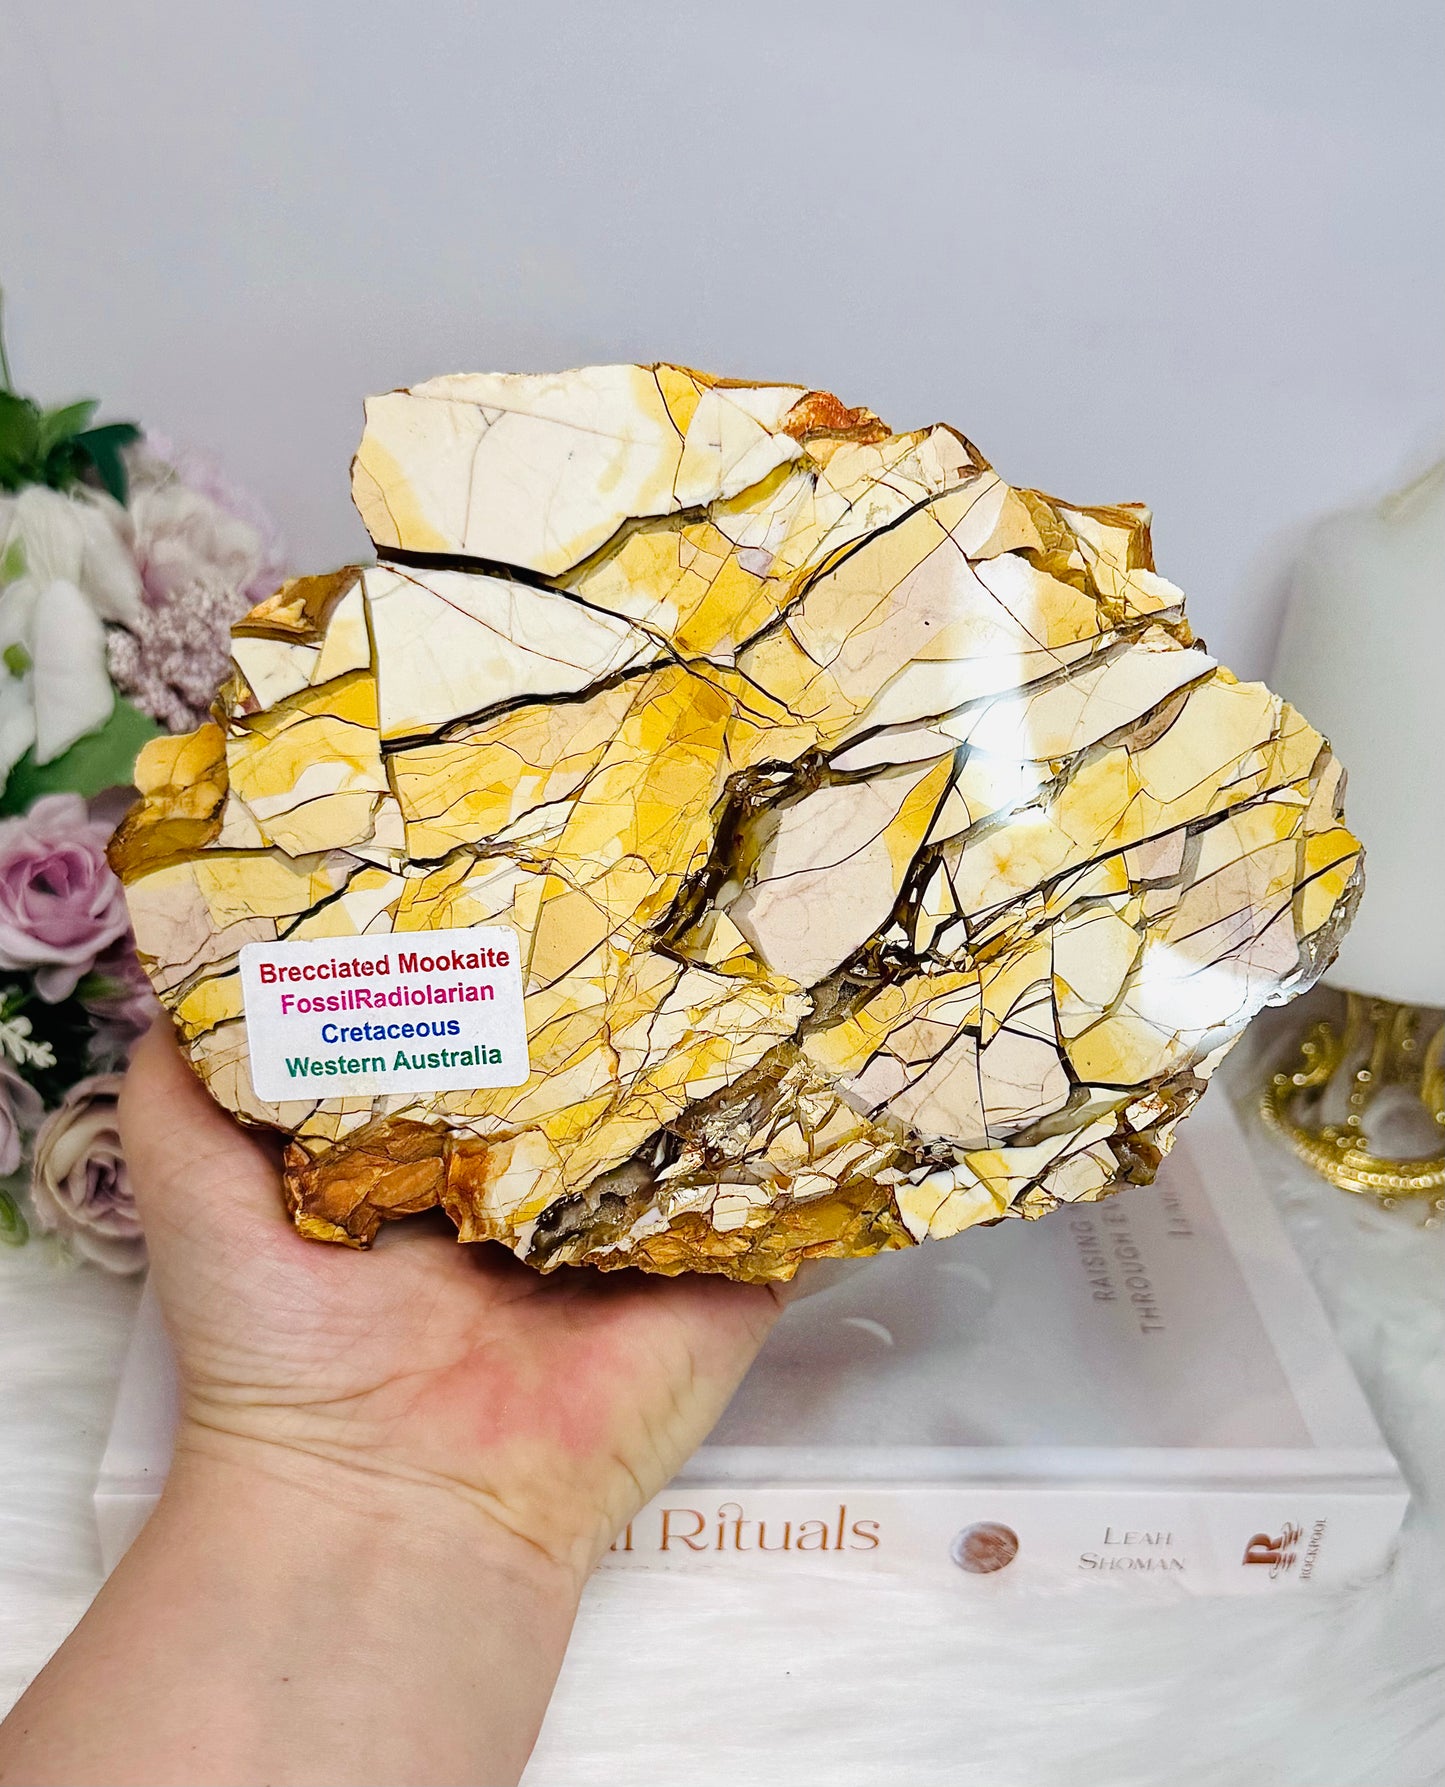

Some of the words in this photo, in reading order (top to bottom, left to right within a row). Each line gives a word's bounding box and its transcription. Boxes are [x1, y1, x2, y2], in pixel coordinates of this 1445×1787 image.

[260, 955, 390, 984] Brecciated
[398, 947, 510, 974] Mookaite
[280, 982, 495, 1015] FossilRadiolarian
[321, 1019, 461, 1044] Cretaceous
[285, 1055, 386, 1078] Western
[393, 1045, 503, 1072] Australia
[1070, 1220, 1118, 1301] RAISING
[1110, 1232, 1166, 1334] THROUGH
[658, 1502, 881, 1551] Rituals
